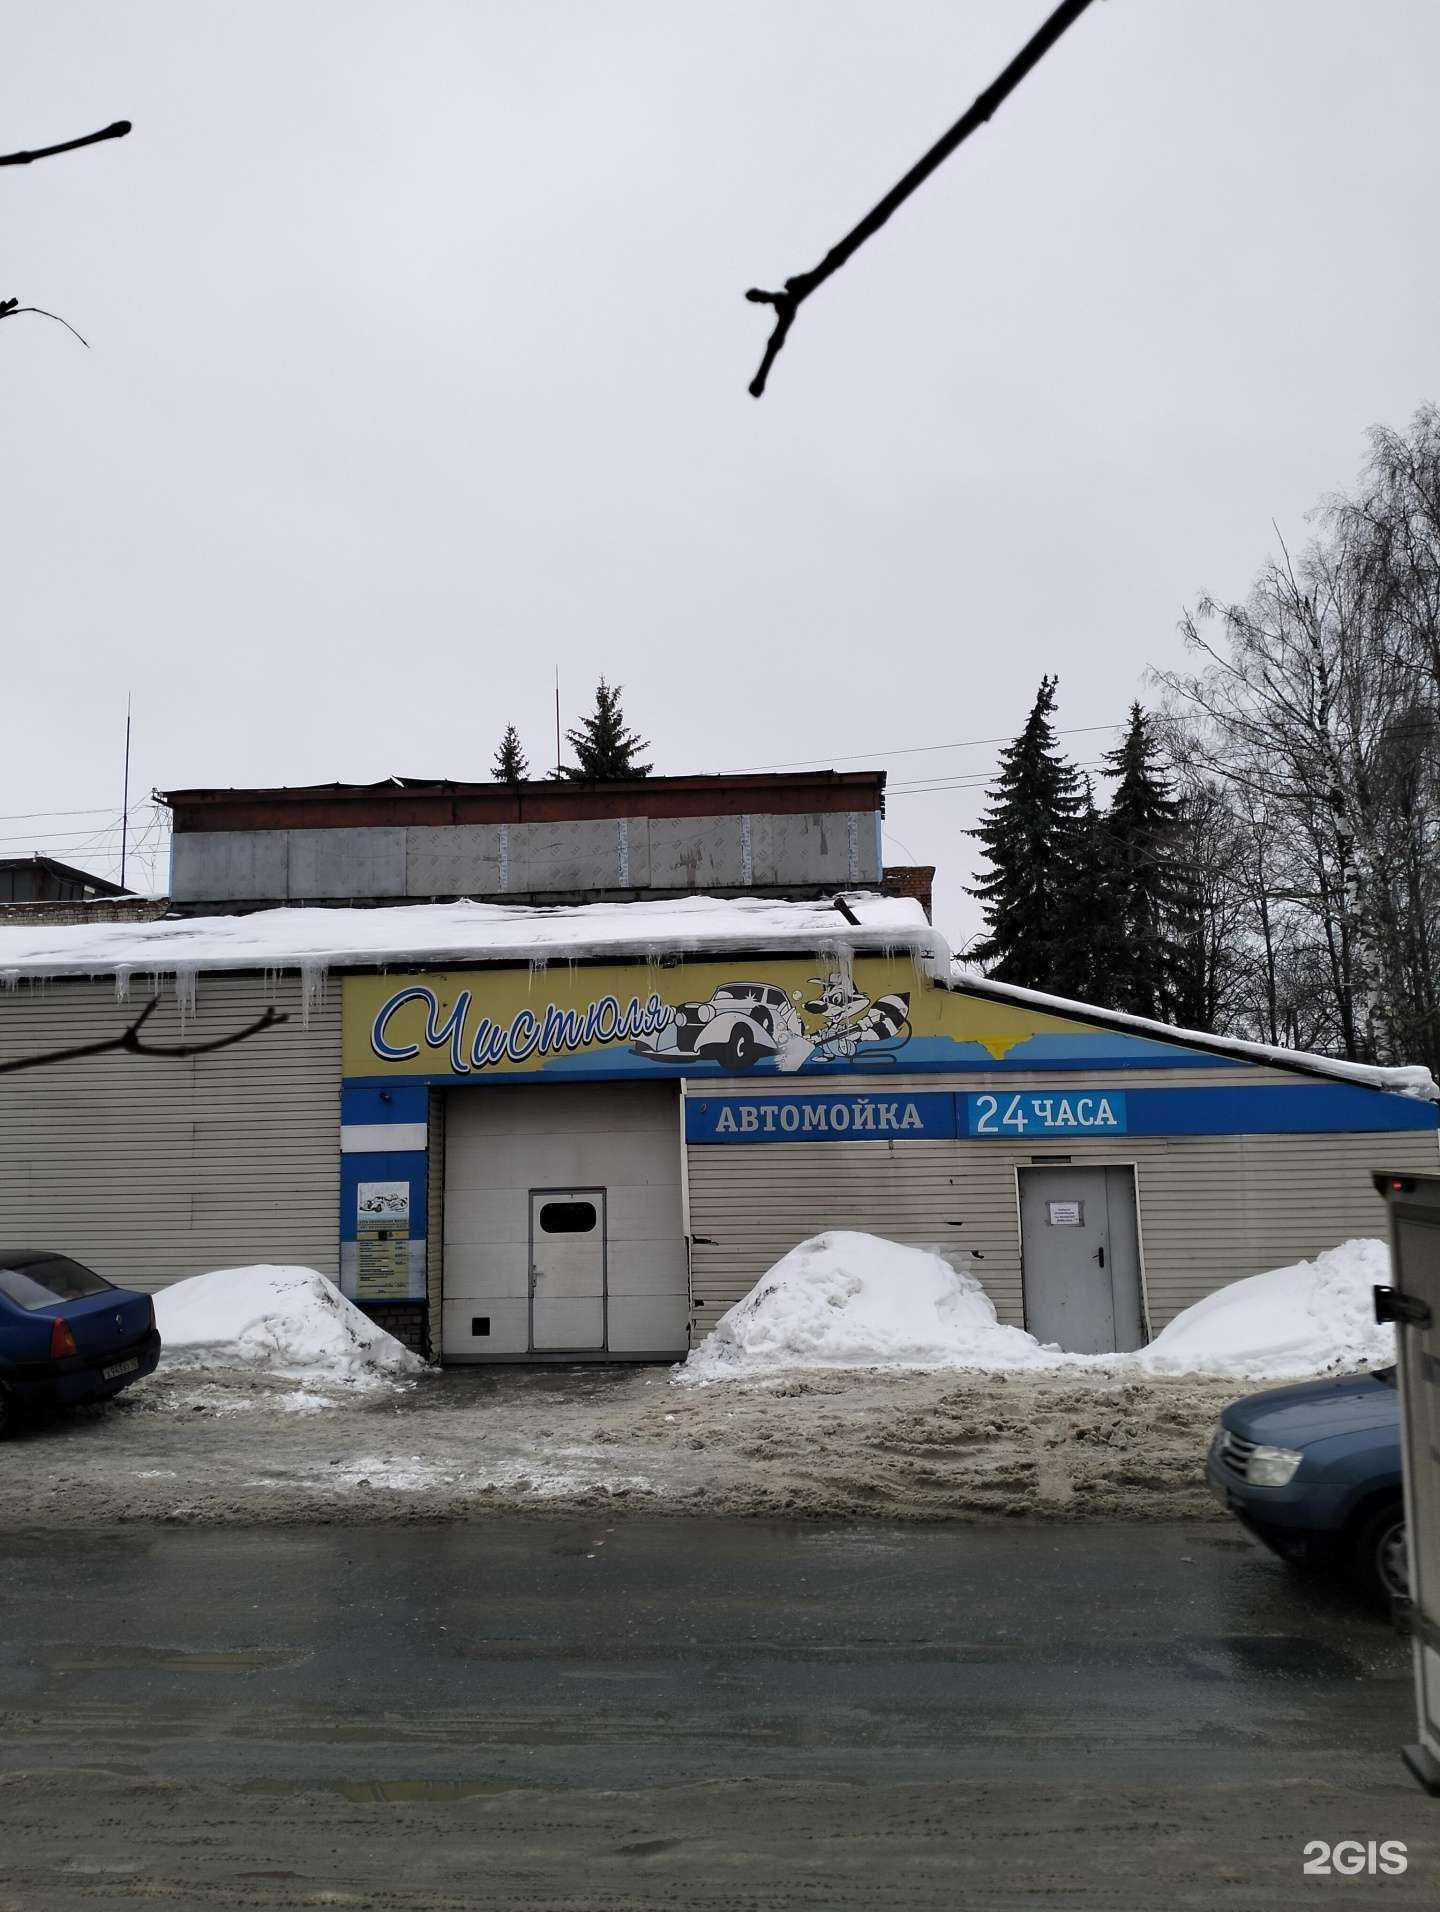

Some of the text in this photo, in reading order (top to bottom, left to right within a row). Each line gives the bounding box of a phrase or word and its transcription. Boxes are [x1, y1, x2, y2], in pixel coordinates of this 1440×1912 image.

[370, 985, 673, 1075] Чистюля
[715, 1099, 924, 1133] АВТОМОЙКА
[976, 1094, 1118, 1134] 24 ЧАСА
